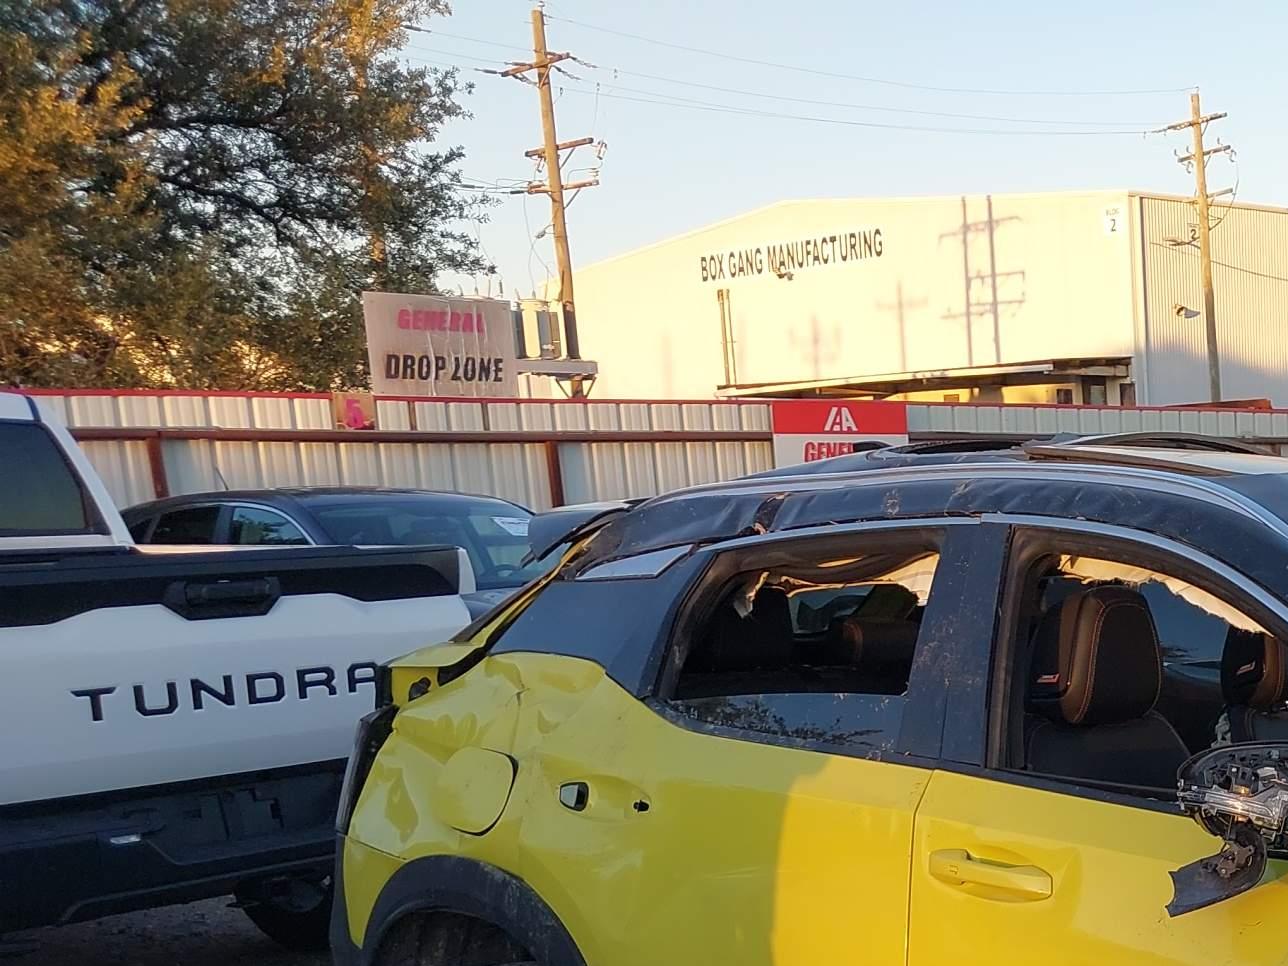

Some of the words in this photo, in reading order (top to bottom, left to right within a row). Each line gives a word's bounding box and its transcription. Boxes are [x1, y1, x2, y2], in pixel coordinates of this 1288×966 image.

[1110, 218, 1116, 232] 2
[701, 254, 726, 282] BOX
[728, 247, 763, 279] GANG
[766, 228, 883, 274] MANUFACTURING
[397, 308, 486, 335] GENERAL
[385, 354, 446, 380] DROP
[451, 357, 504, 382] ZONE
[70, 660, 378, 722] TUNDRA
